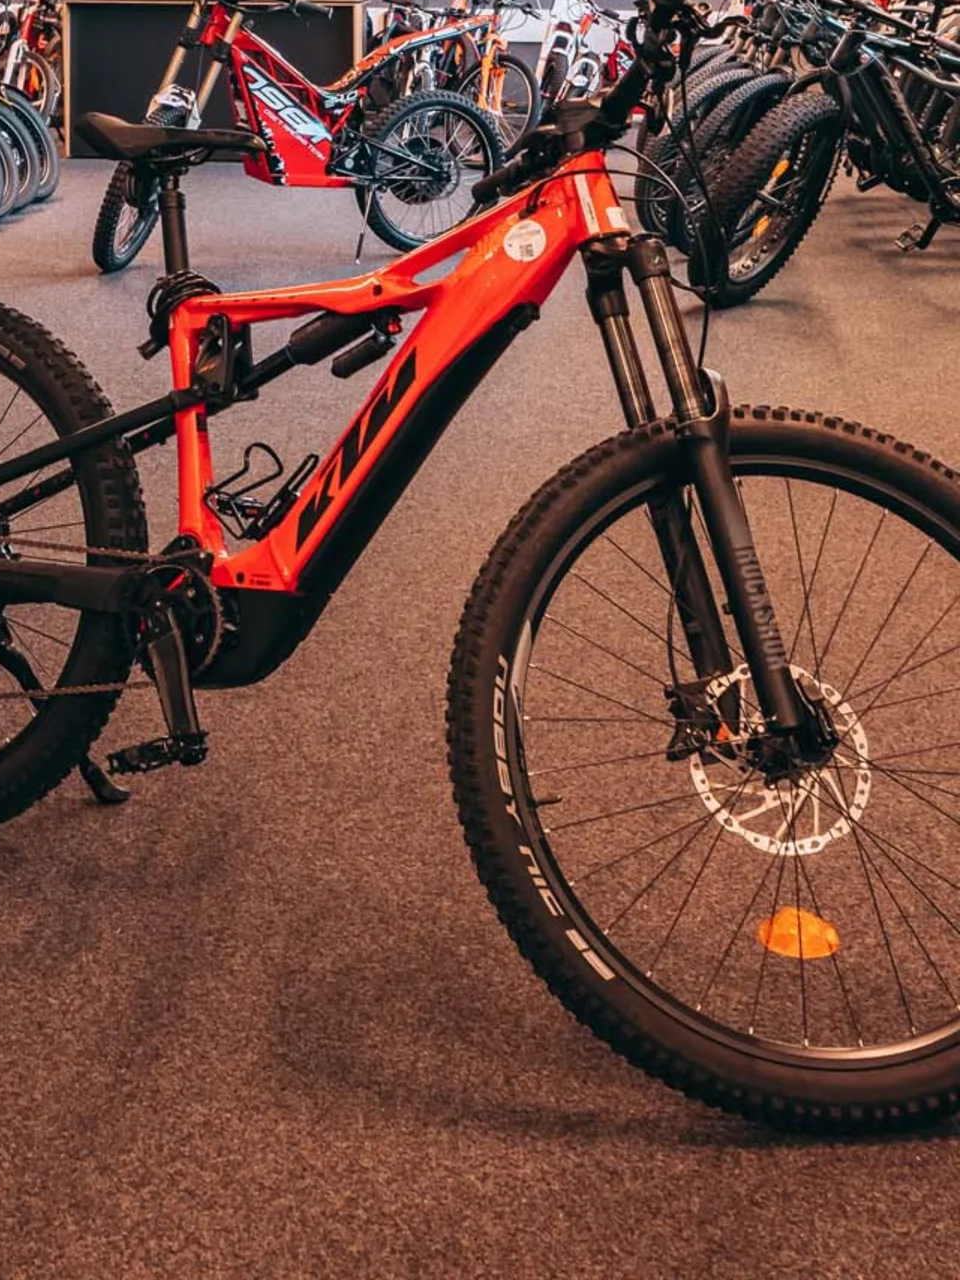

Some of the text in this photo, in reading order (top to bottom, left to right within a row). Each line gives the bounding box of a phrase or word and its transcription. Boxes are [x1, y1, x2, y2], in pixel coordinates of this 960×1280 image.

[296, 346, 417, 554] KTM
[493, 654, 564, 917] NOBBY NIC
